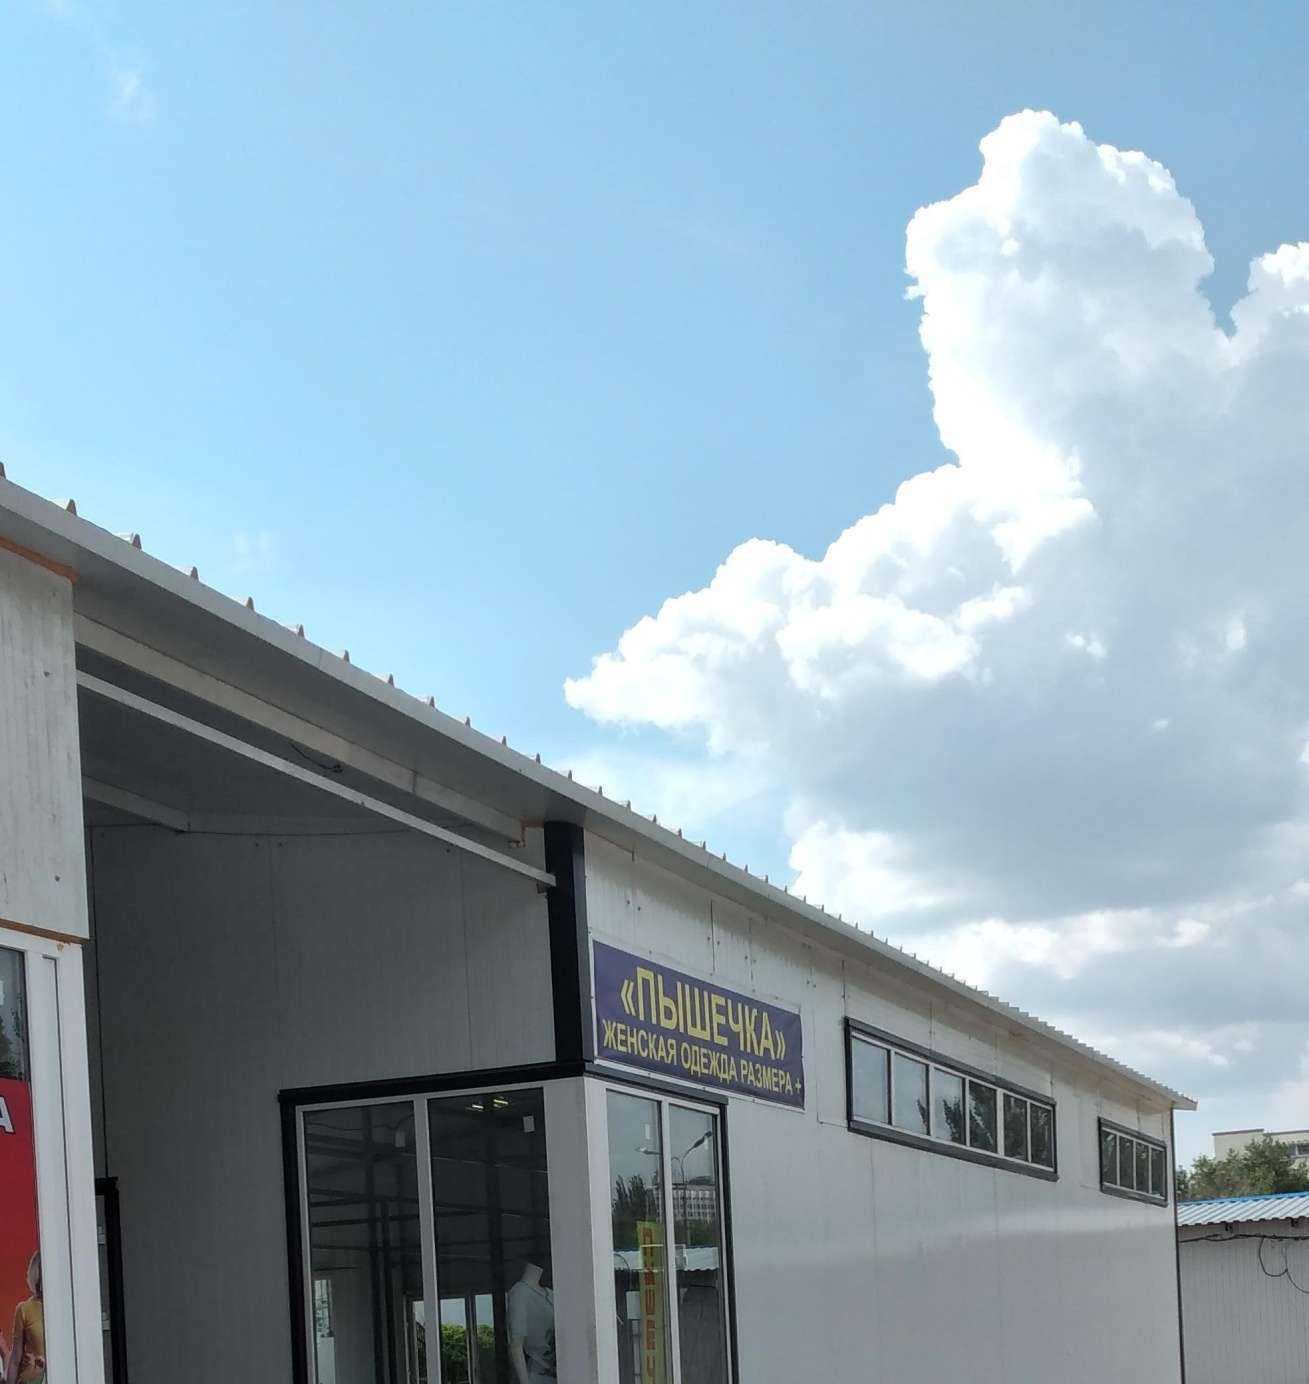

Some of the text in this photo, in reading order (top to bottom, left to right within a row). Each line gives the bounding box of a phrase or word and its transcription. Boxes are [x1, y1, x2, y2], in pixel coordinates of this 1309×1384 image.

[602, 1018, 677, 1066] ЖЕНСКАЯ
[680, 1042, 738, 1084] ОДЕЖДА
[740, 1059, 793, 1095] РАЗМЕРА
[620, 966, 786, 1061] «ПЫШЕЧКА»
